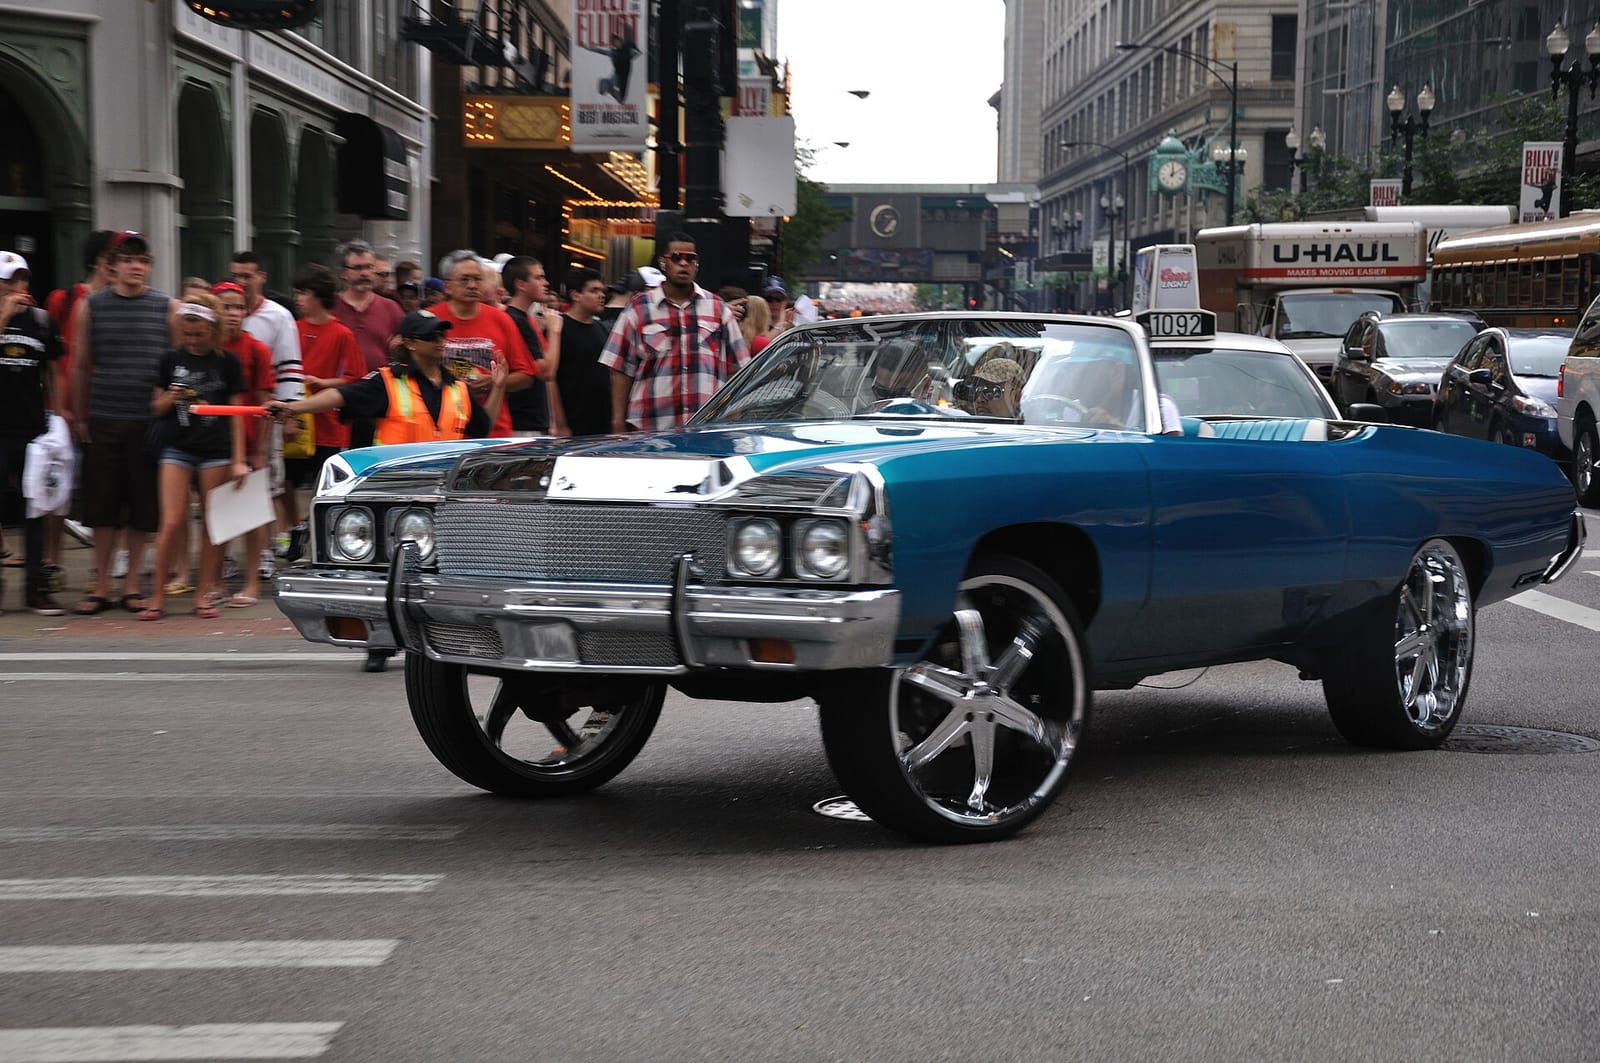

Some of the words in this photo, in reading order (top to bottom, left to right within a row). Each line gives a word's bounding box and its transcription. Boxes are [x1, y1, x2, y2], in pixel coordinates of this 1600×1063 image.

[602, 111, 639, 125] MUSICAL
[1525, 150, 1554, 167] BILLY
[1373, 185, 1395, 200] BILLY
[1273, 242, 1399, 263] U-HAUL
[1161, 267, 1192, 282] Coors
[1287, 268, 1317, 277] MAKES
[1319, 268, 1355, 276] MOVING
[1357, 267, 1387, 276] EASIER
[1161, 280, 1190, 289] LIGHT
[1152, 314, 1201, 335] 1092
